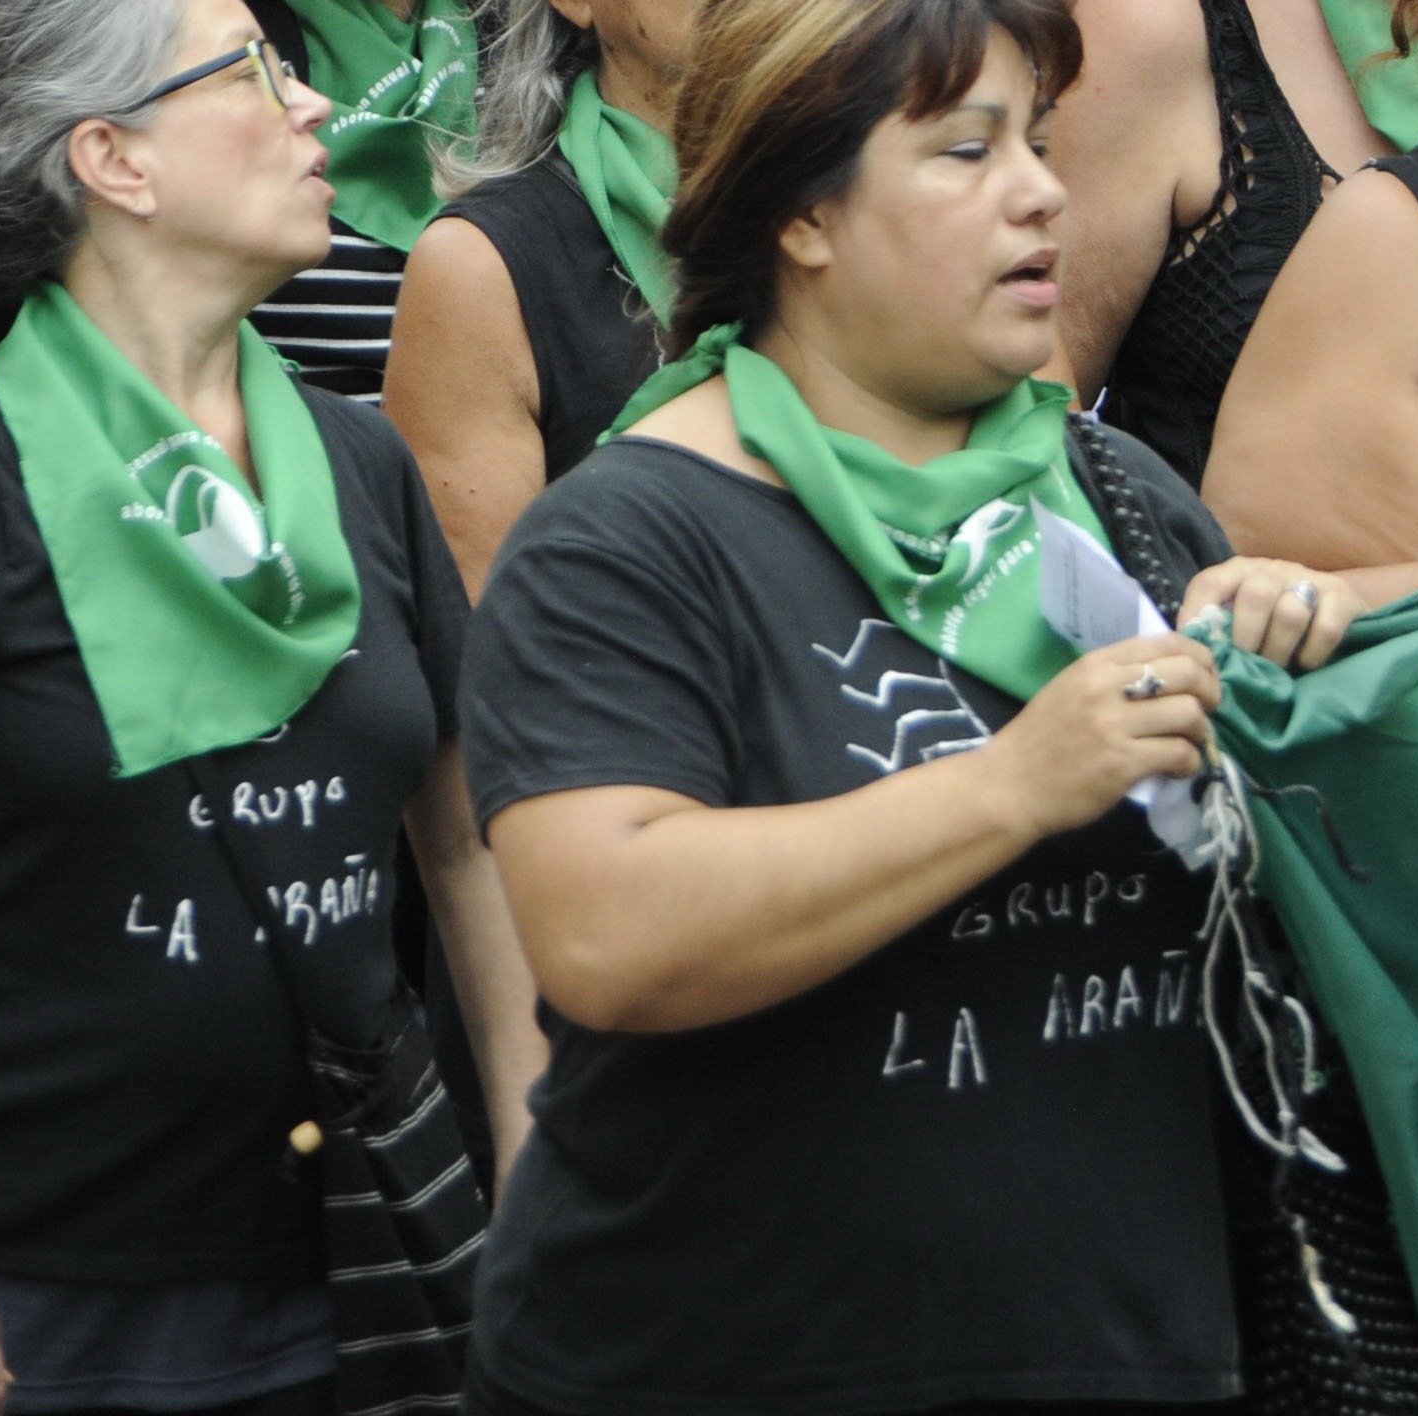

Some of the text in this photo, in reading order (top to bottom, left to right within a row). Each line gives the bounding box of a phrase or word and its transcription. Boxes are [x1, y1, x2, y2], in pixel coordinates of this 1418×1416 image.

[123, 892, 200, 965] LA
[882, 949, 1205, 1090] LA ARAÑ
